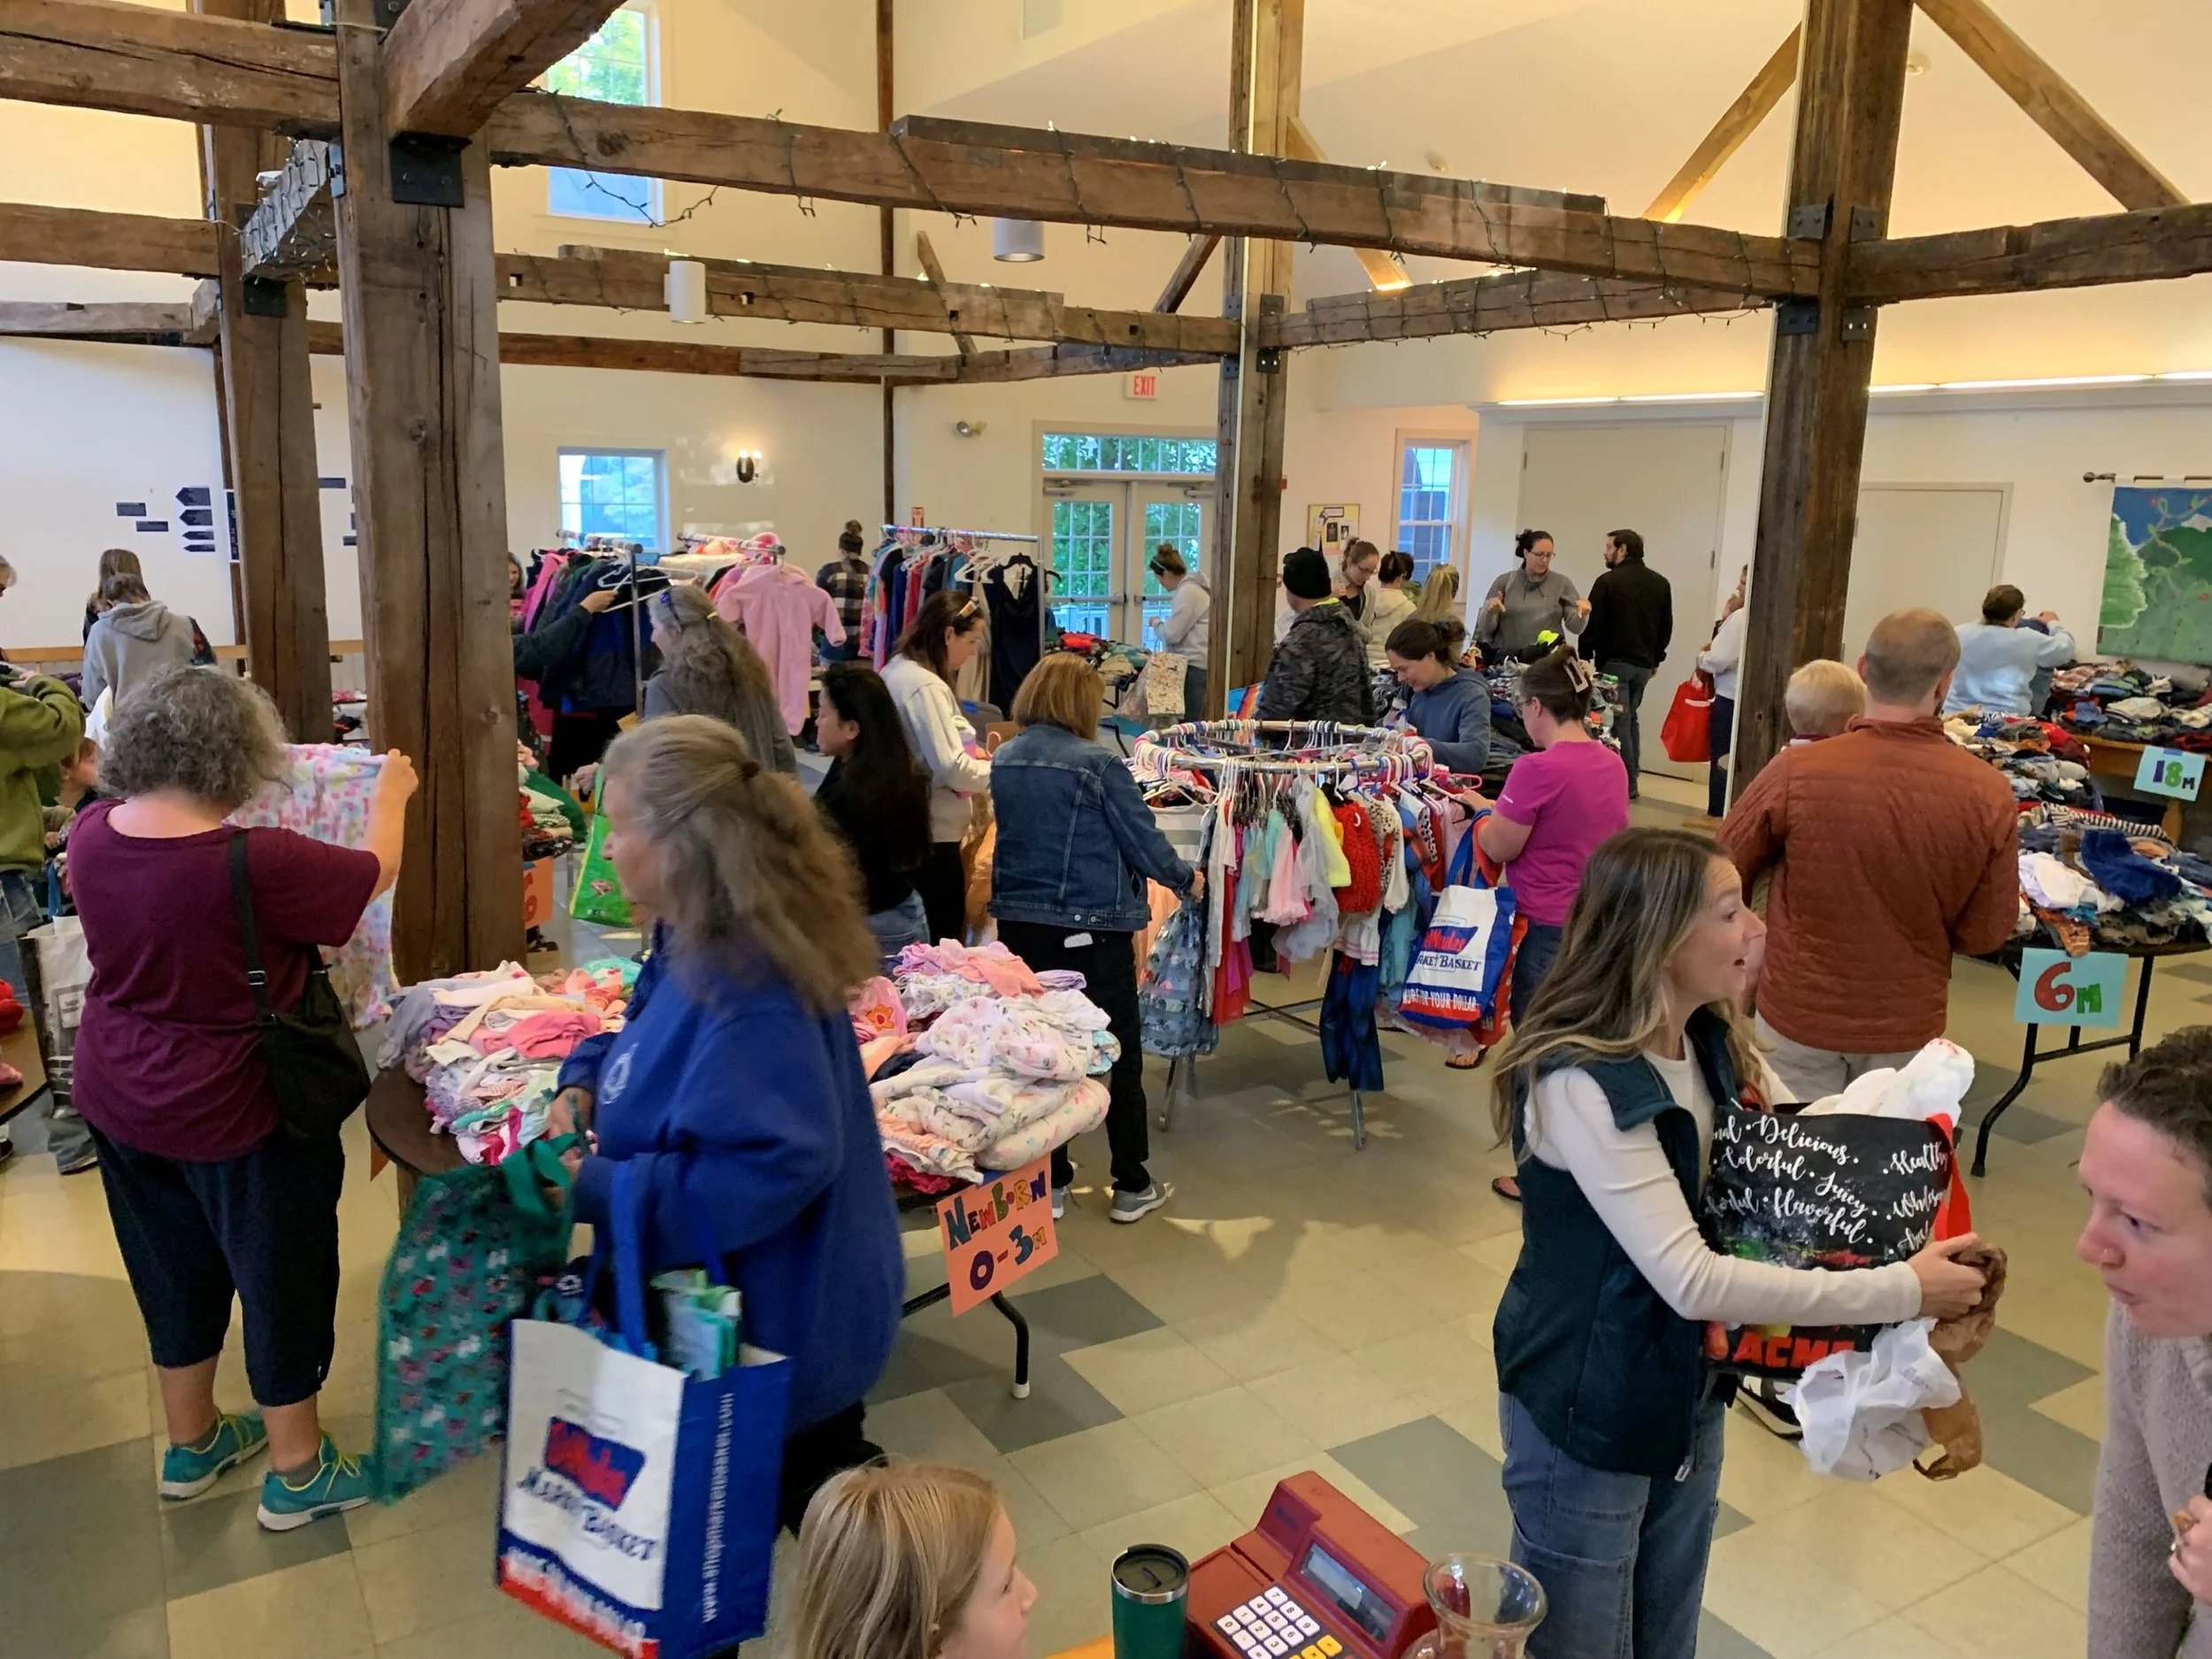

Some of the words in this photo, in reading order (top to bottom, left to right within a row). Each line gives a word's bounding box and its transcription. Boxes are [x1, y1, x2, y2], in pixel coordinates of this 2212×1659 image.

[1133, 374, 1156, 396] EXIT
[2152, 760, 2195, 790] 18M
[1440, 955, 1481, 972] BASKET
[1431, 991, 1452, 1010] YOUR
[1453, 994, 1477, 1012] DOLLAR
[2034, 961, 2102, 1014] 6M
[1752, 1114, 1851, 1166] Delicious
[1722, 1145, 1807, 1181] Colorful
[1815, 1171, 1869, 1218] Juicy
[1772, 1187, 1872, 1245] Flavorful
